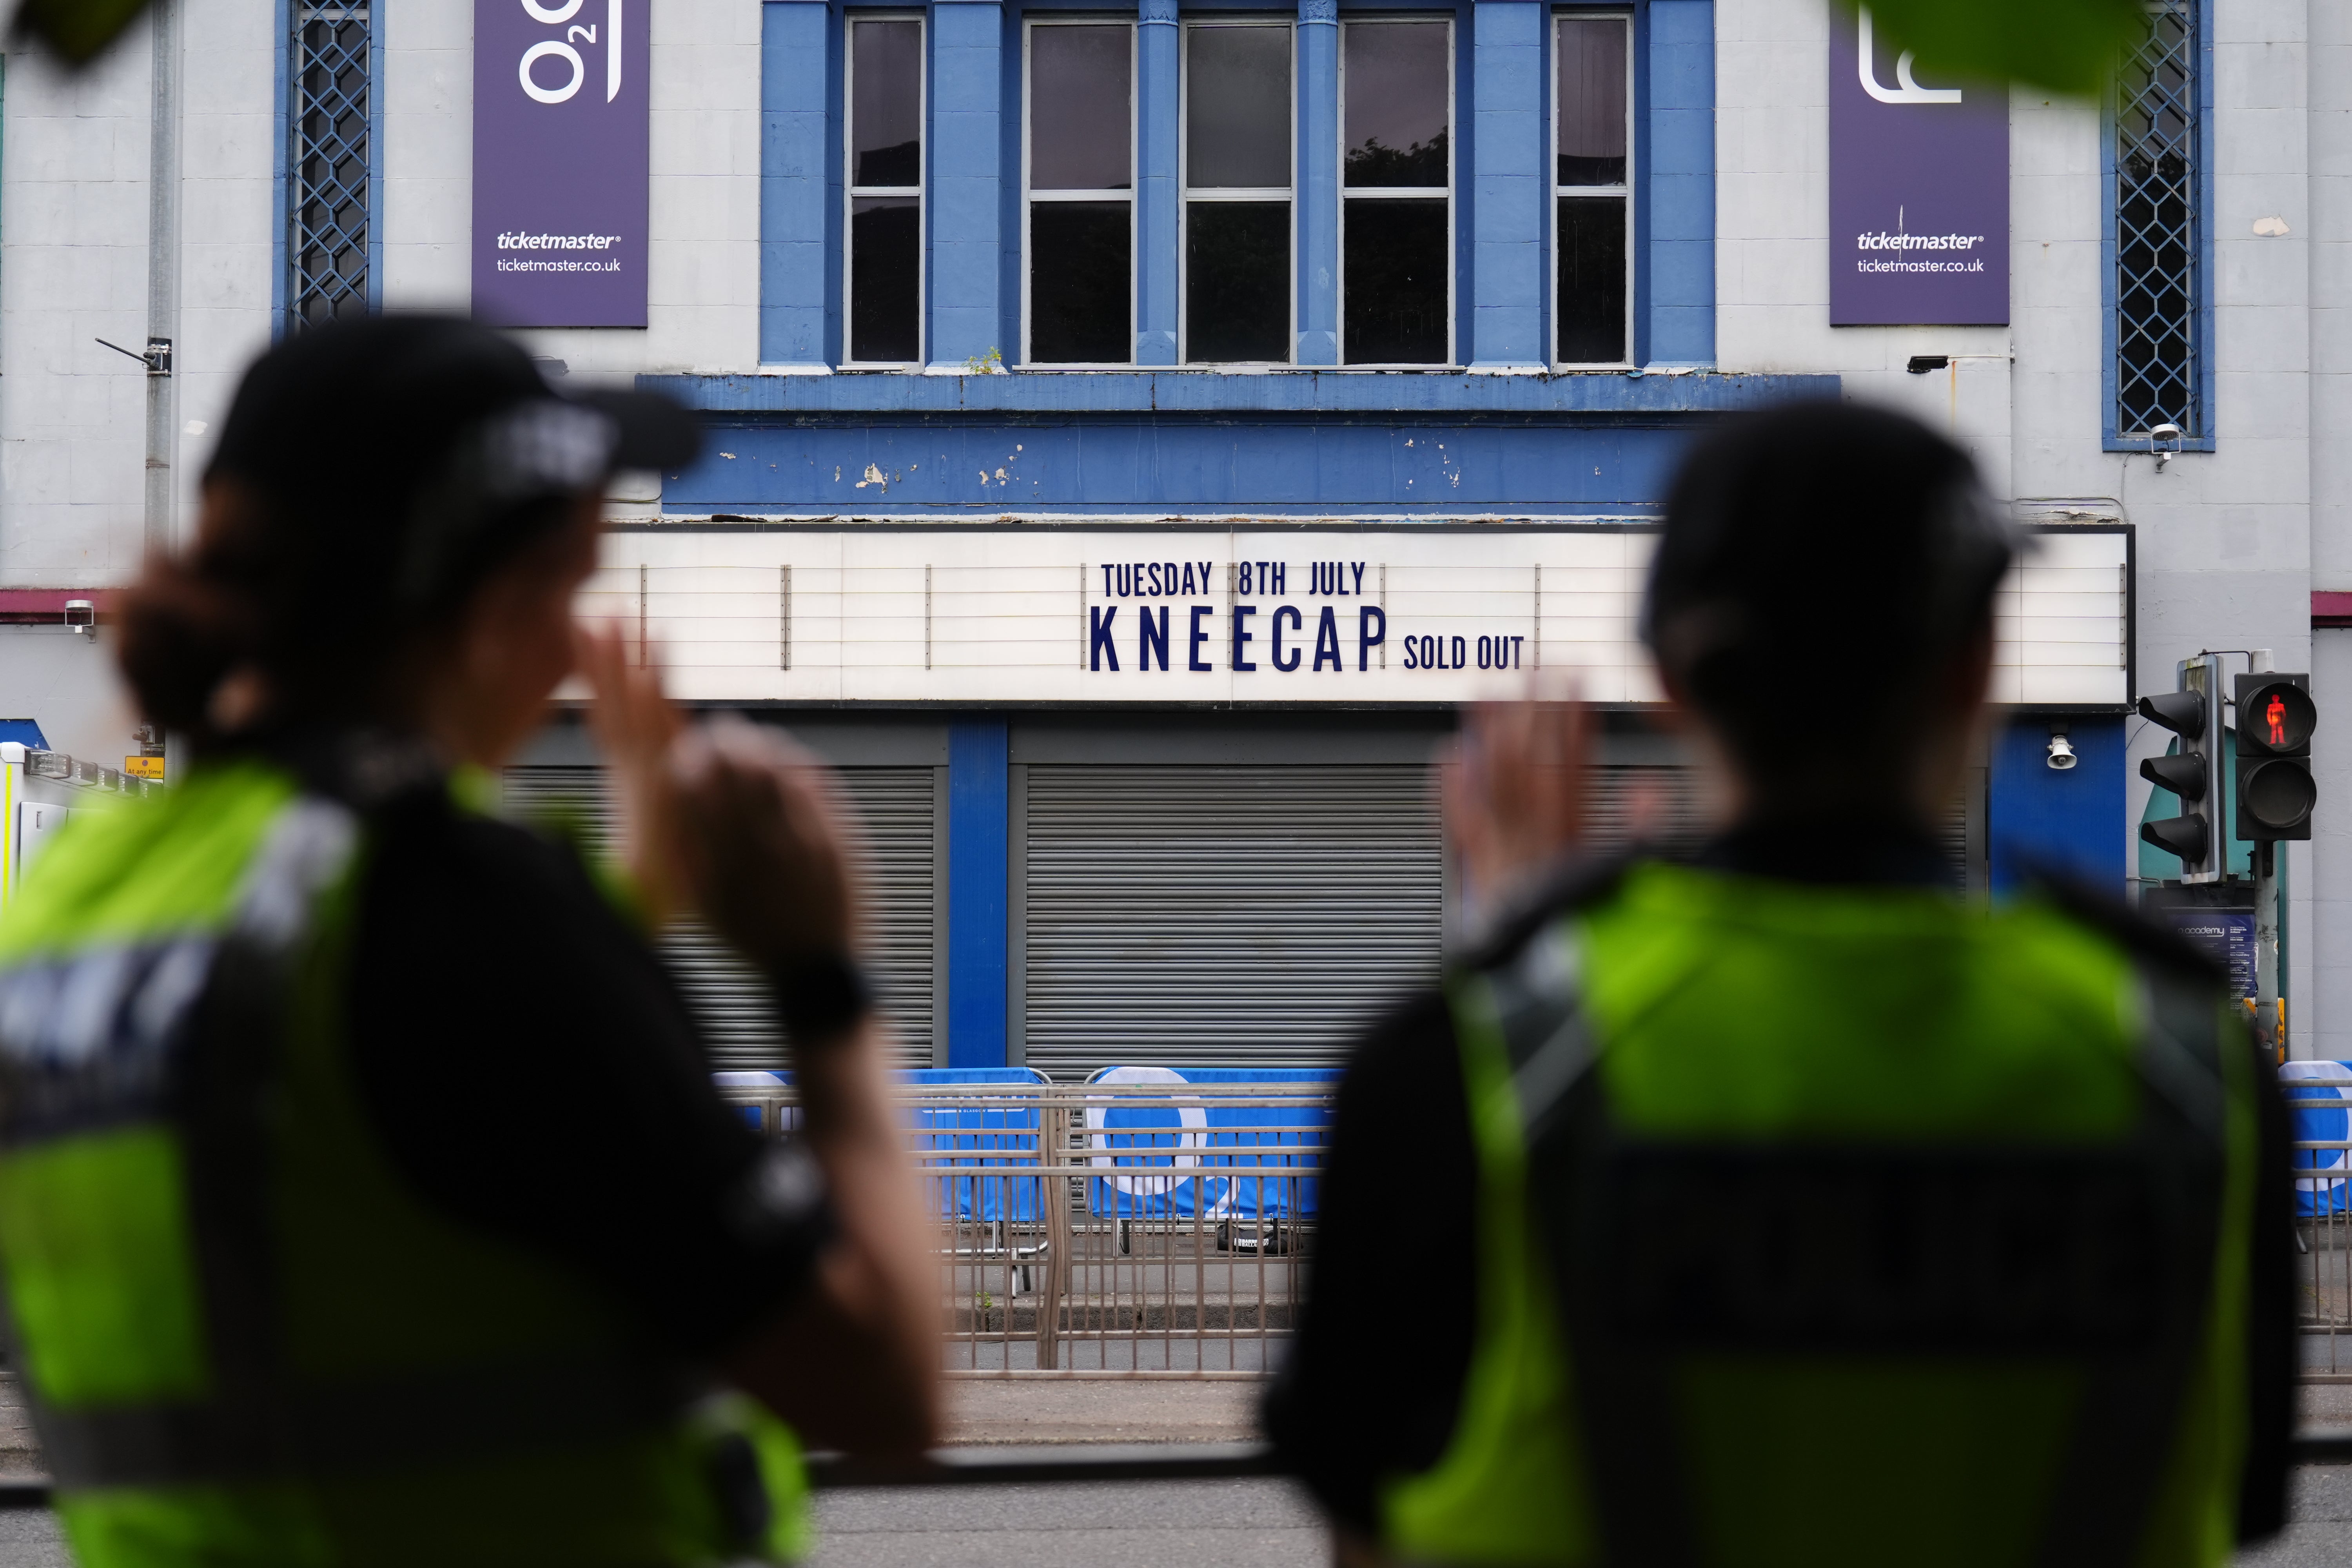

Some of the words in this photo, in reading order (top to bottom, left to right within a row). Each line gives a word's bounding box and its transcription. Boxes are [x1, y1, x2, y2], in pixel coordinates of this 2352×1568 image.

[497, 258, 621, 271] ticketmaster.co.uk
[1858, 258, 1984, 272] ticketmaster.co.uk
[1101, 561, 1212, 597] TUESDAY
[1239, 561, 1285, 595] 8TH
[1309, 561, 1366, 595] JULY
[1089, 605, 1387, 672] KNEECAP
[1403, 635, 1465, 670] SOLD
[1477, 635, 1524, 670] OUT
[2185, 926, 2225, 937] academy
